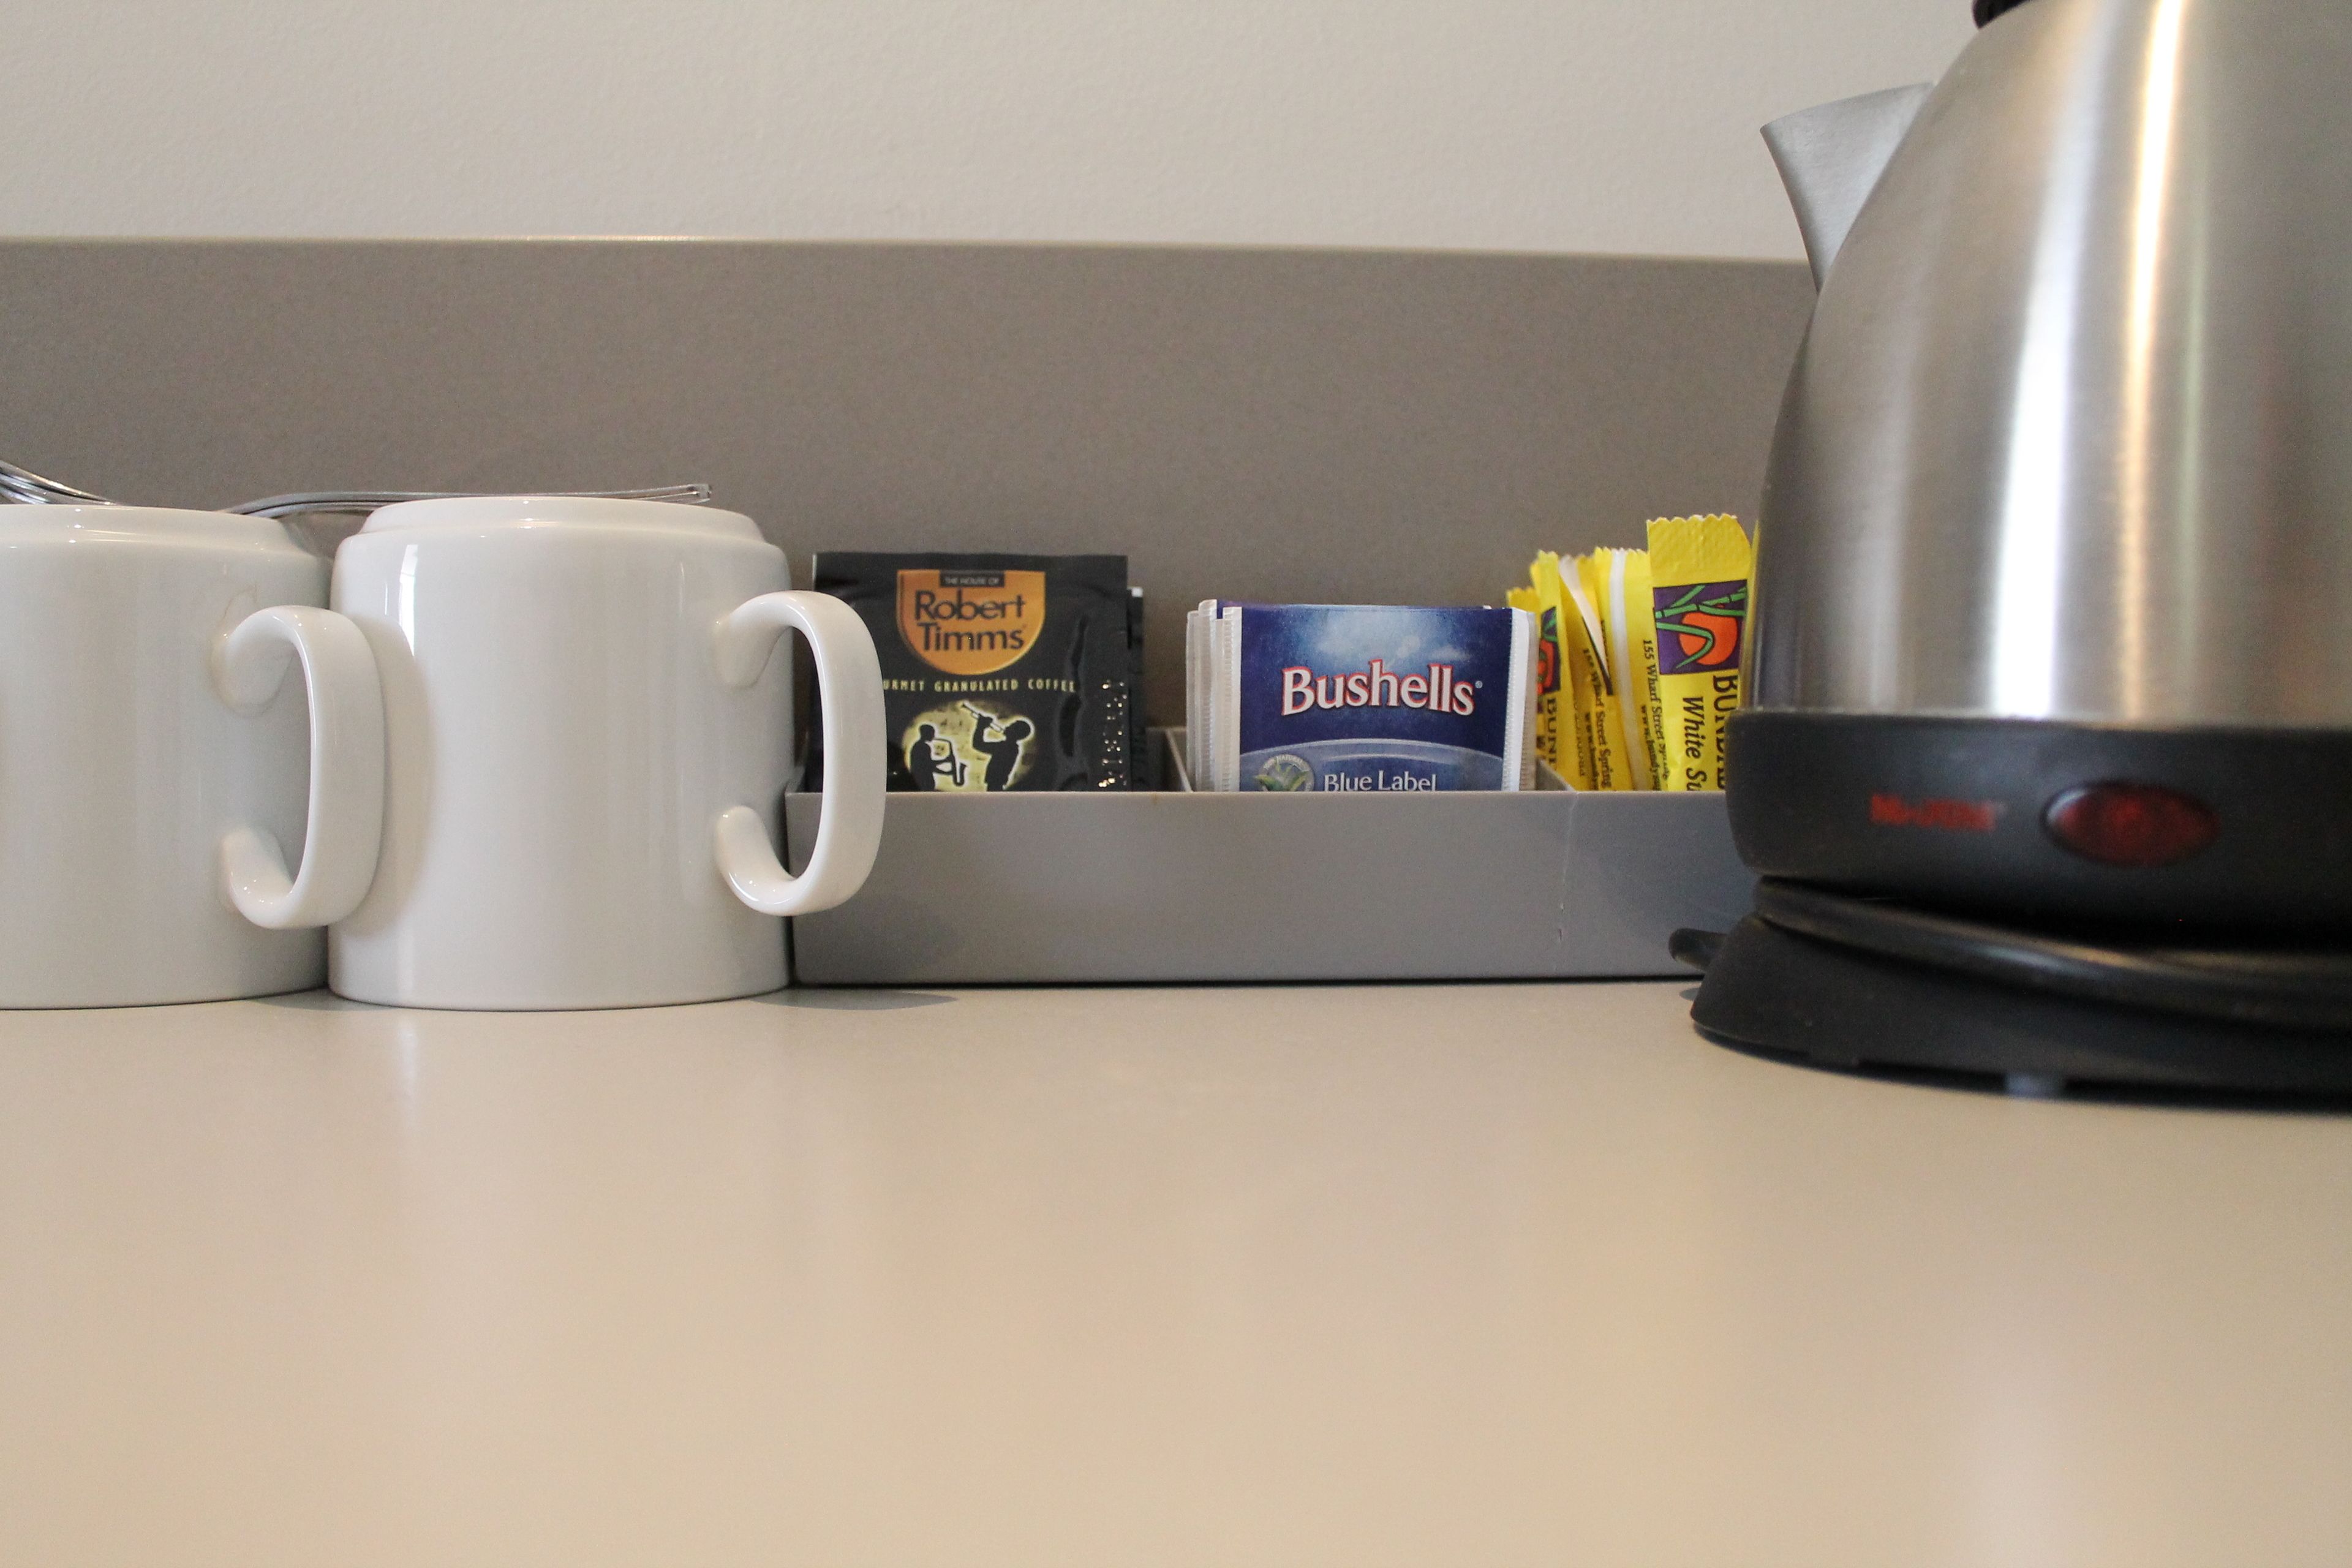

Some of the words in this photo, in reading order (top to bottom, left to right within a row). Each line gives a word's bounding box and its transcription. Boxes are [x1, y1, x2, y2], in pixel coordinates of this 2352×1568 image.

[915, 588, 1027, 621] Robert
[918, 622, 1025, 651] Timms
[1643, 639, 1655, 660] 155
[934, 679, 1019, 692] GRANULATED
[1028, 678, 1076, 693] COFFEE
[1281, 658, 1475, 716] Bushells
[1646, 665, 1660, 703] Wharf
[1651, 706, 1666, 740] Street
[1683, 696, 1706, 760] White
[1324, 772, 1373, 791] Blue
[1378, 769, 1437, 791] Label
